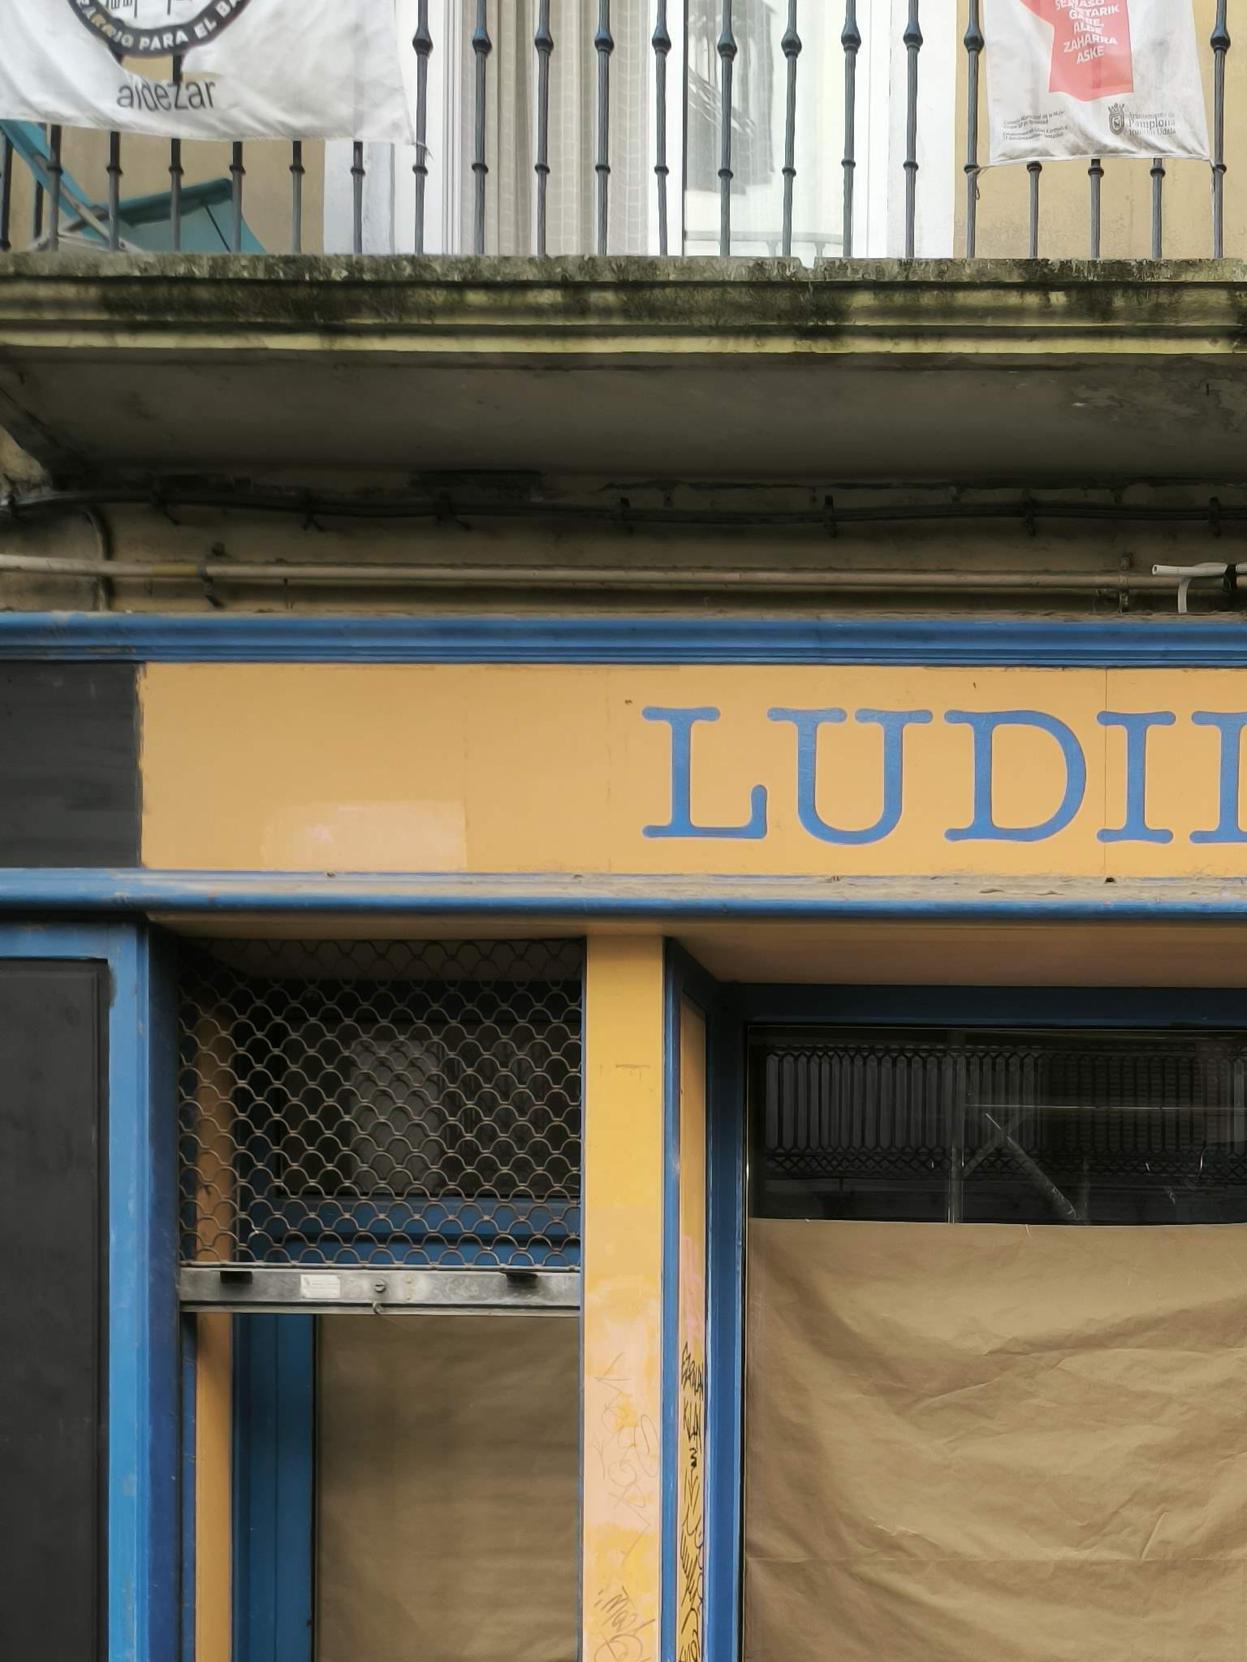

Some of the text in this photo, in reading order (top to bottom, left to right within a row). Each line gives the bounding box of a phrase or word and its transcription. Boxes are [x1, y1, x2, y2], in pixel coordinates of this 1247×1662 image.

[138, 30, 189, 50] PARA
[194, 18, 217, 39] EL
[1076, 45, 1104, 64] ASKE
